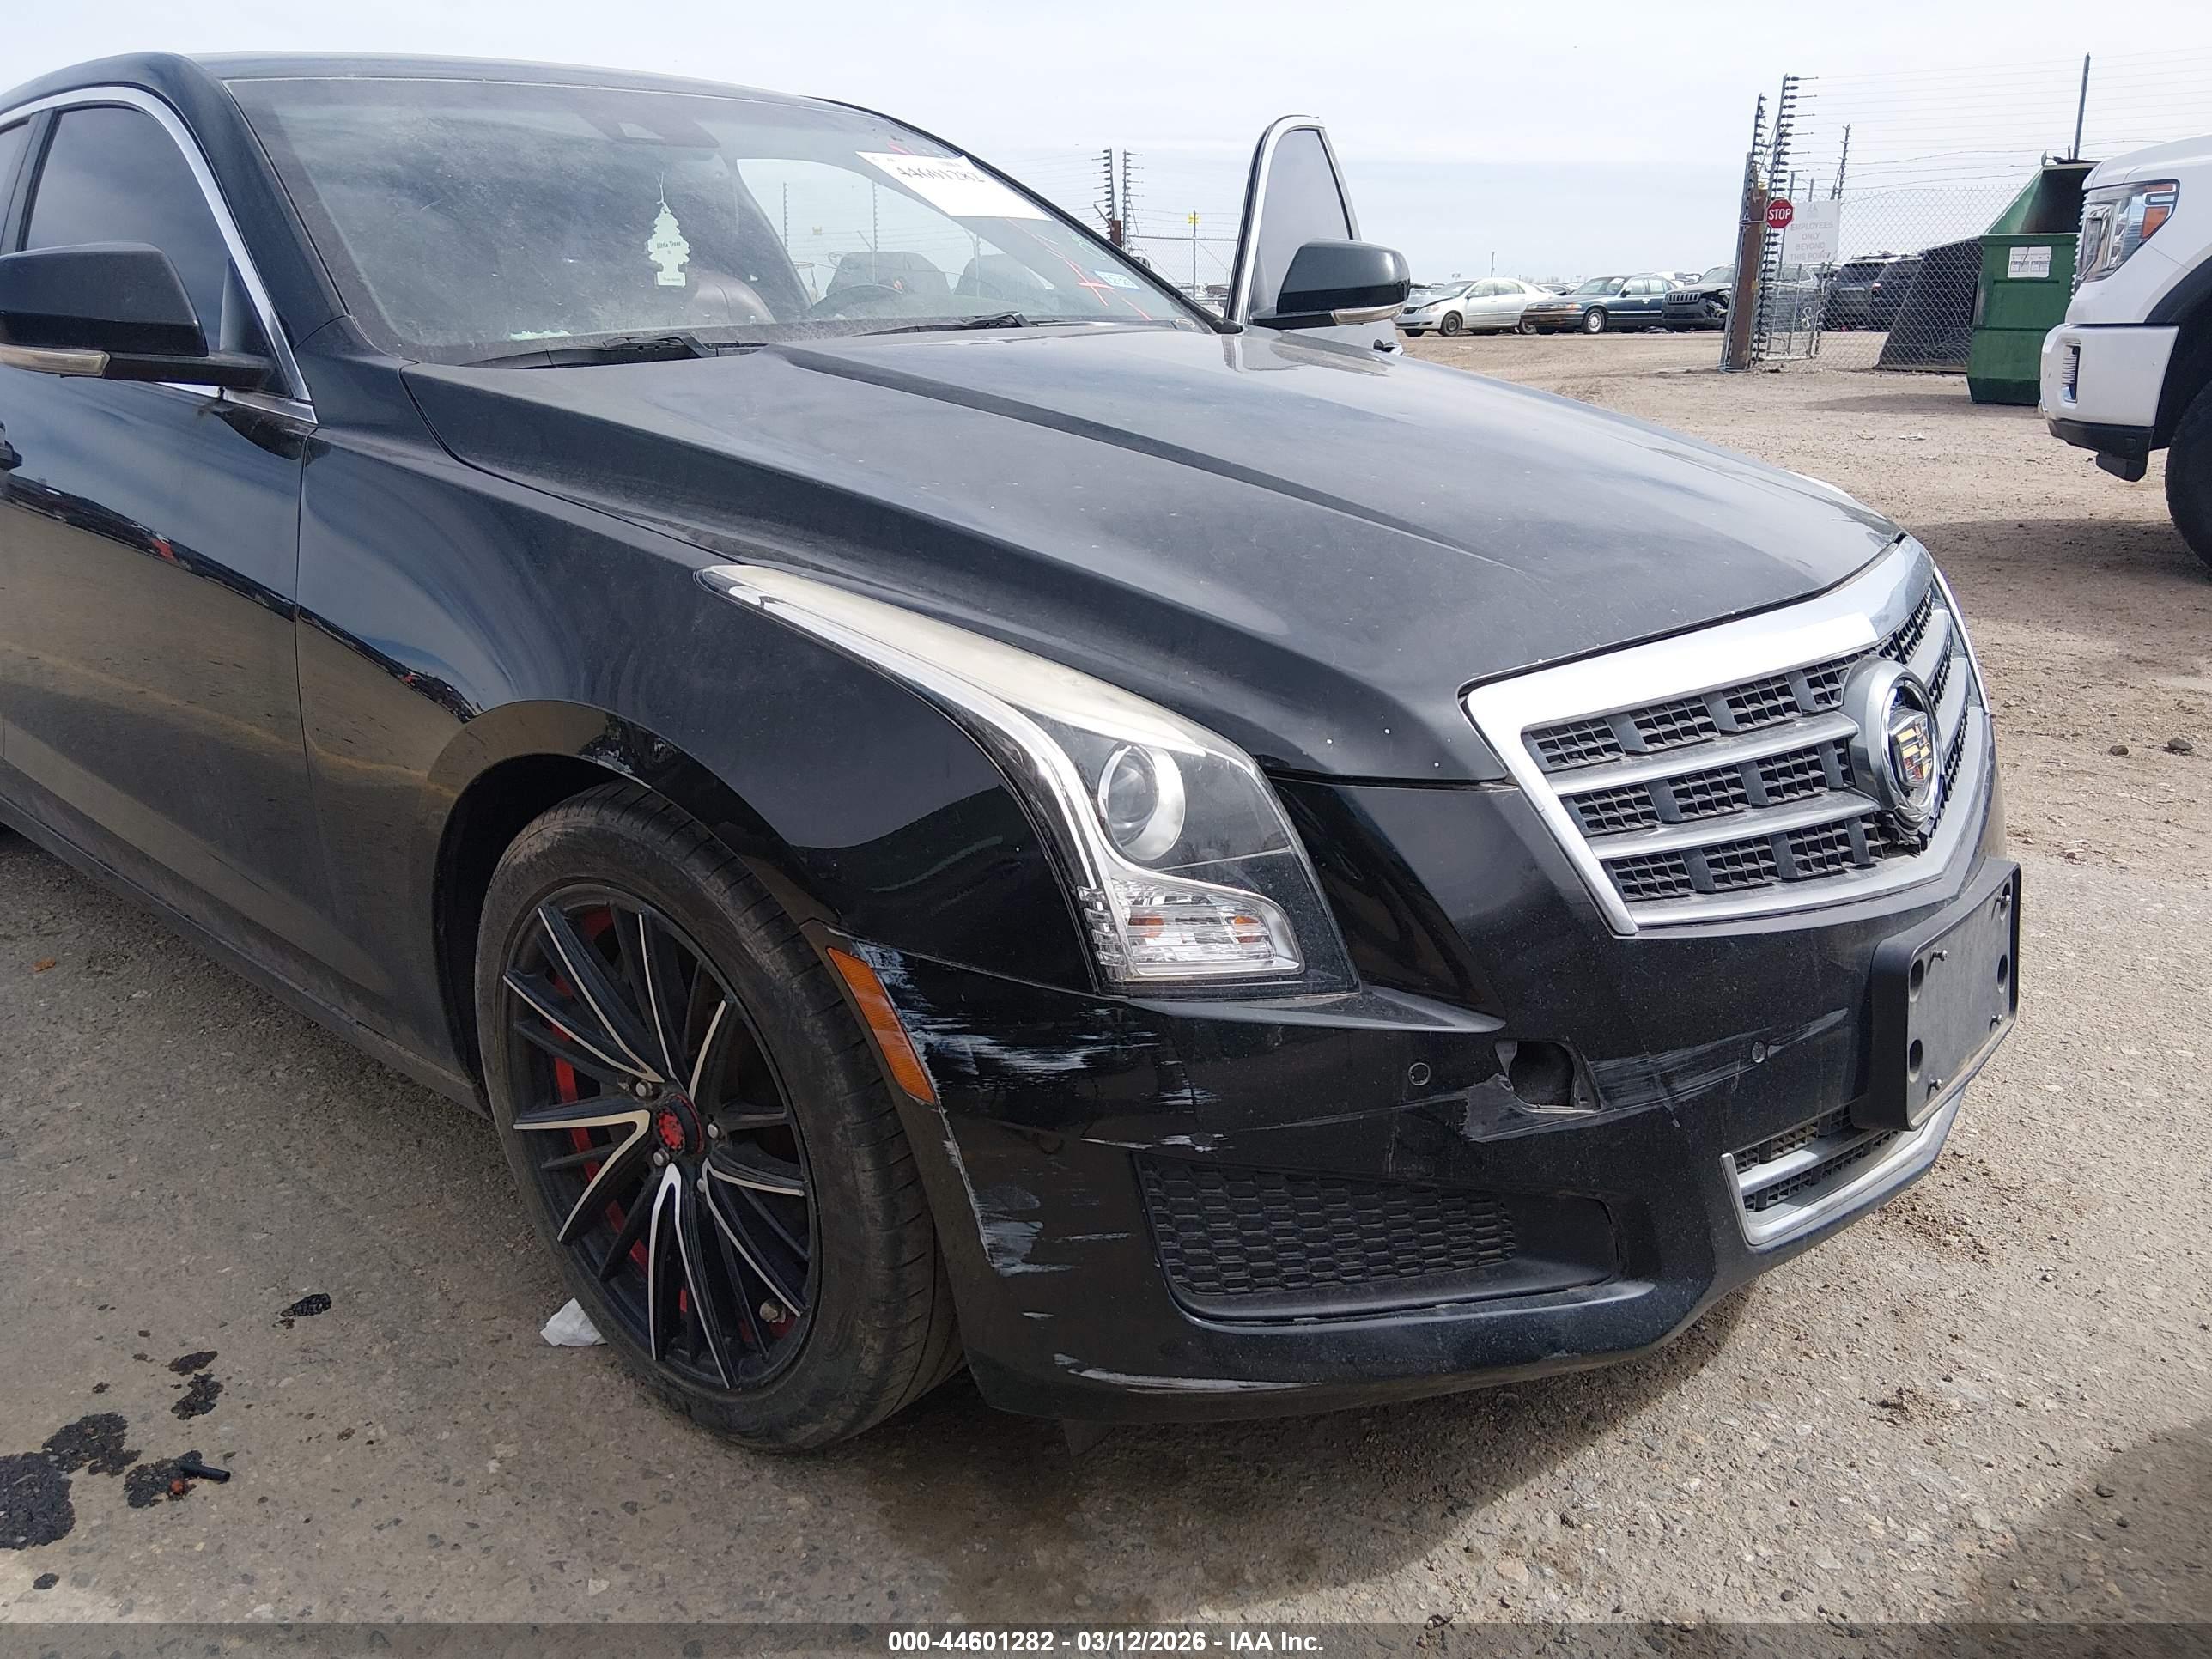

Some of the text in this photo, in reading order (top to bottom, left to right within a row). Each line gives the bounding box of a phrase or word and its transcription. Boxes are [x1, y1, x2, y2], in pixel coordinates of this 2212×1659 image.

[1768, 208, 1791, 221] STOP
[1790, 221, 1833, 231] EMPLOYEES
[1795, 241, 1826, 251] BEYOND
[1789, 252, 1806, 261] THIS
